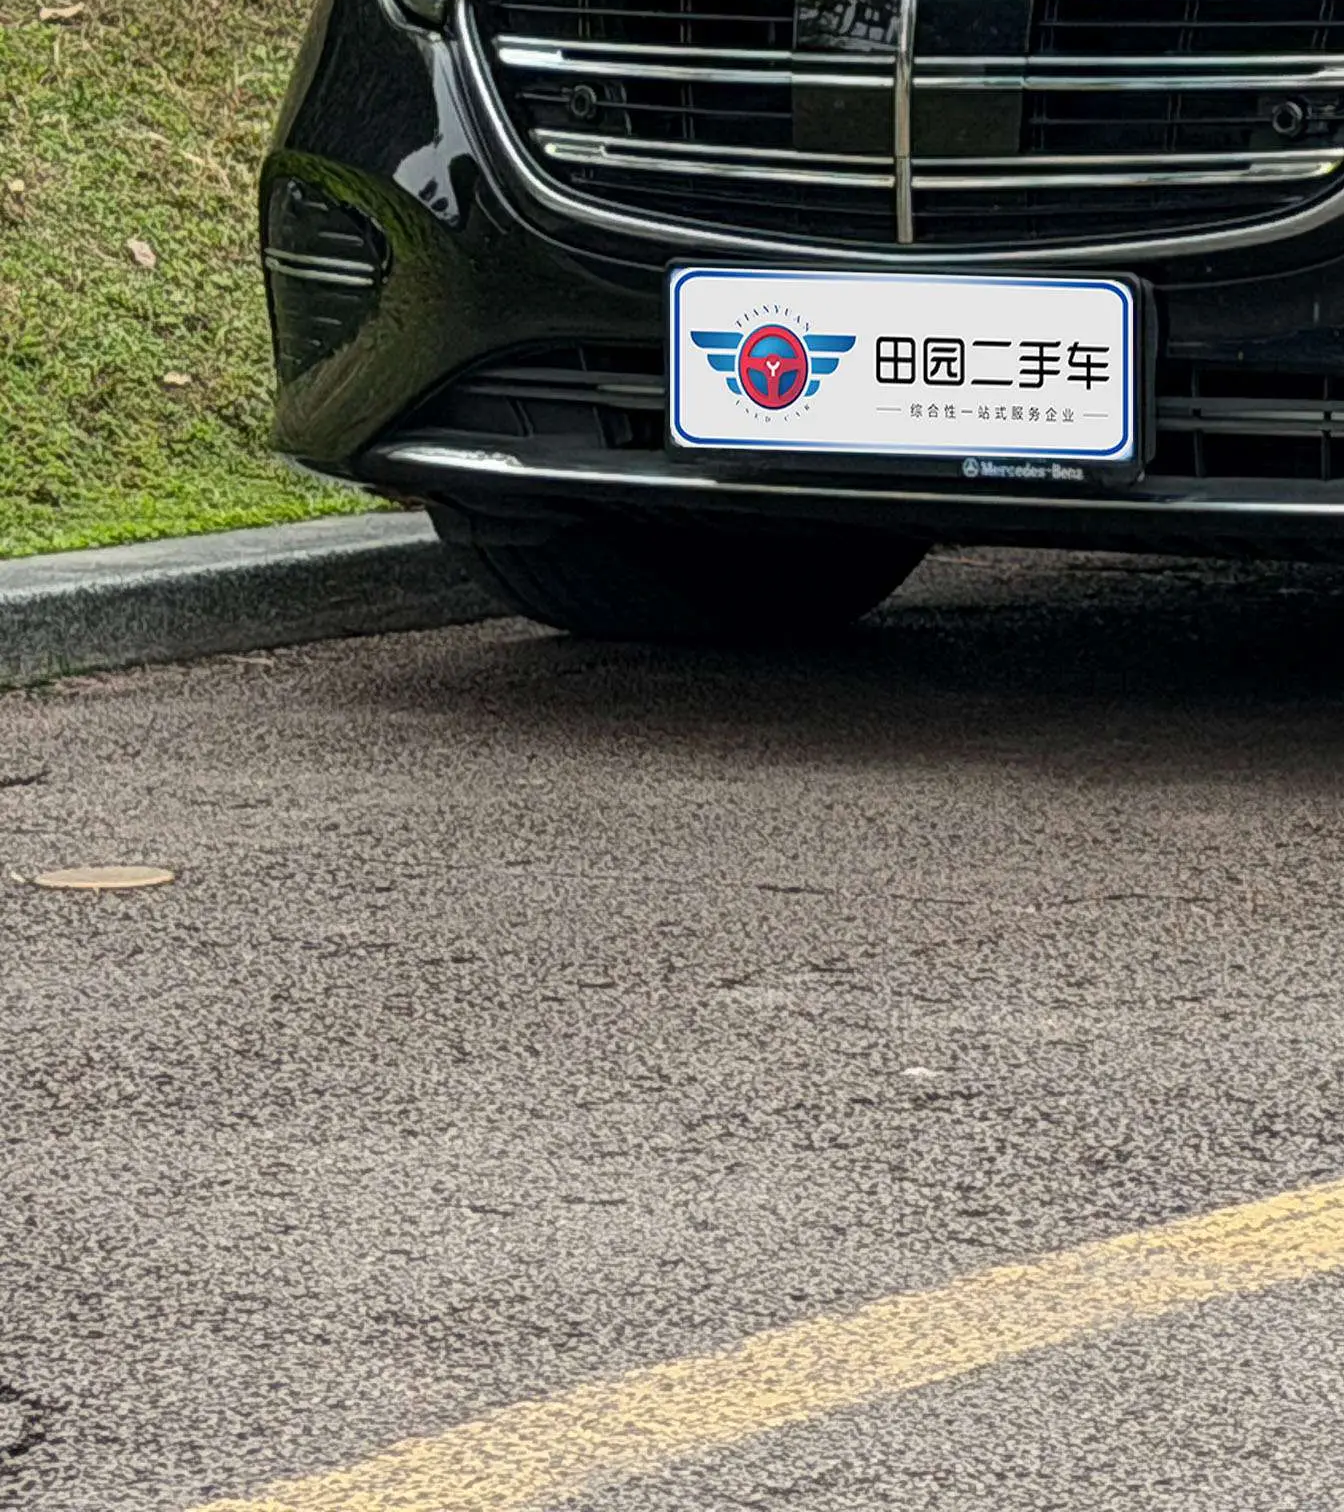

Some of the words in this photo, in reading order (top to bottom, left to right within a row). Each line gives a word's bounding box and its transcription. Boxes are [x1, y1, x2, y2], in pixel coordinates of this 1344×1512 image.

[876, 336, 1110, 390] 田园二手车
[910, 403, 1075, 423] 综合性一站式服务企业
